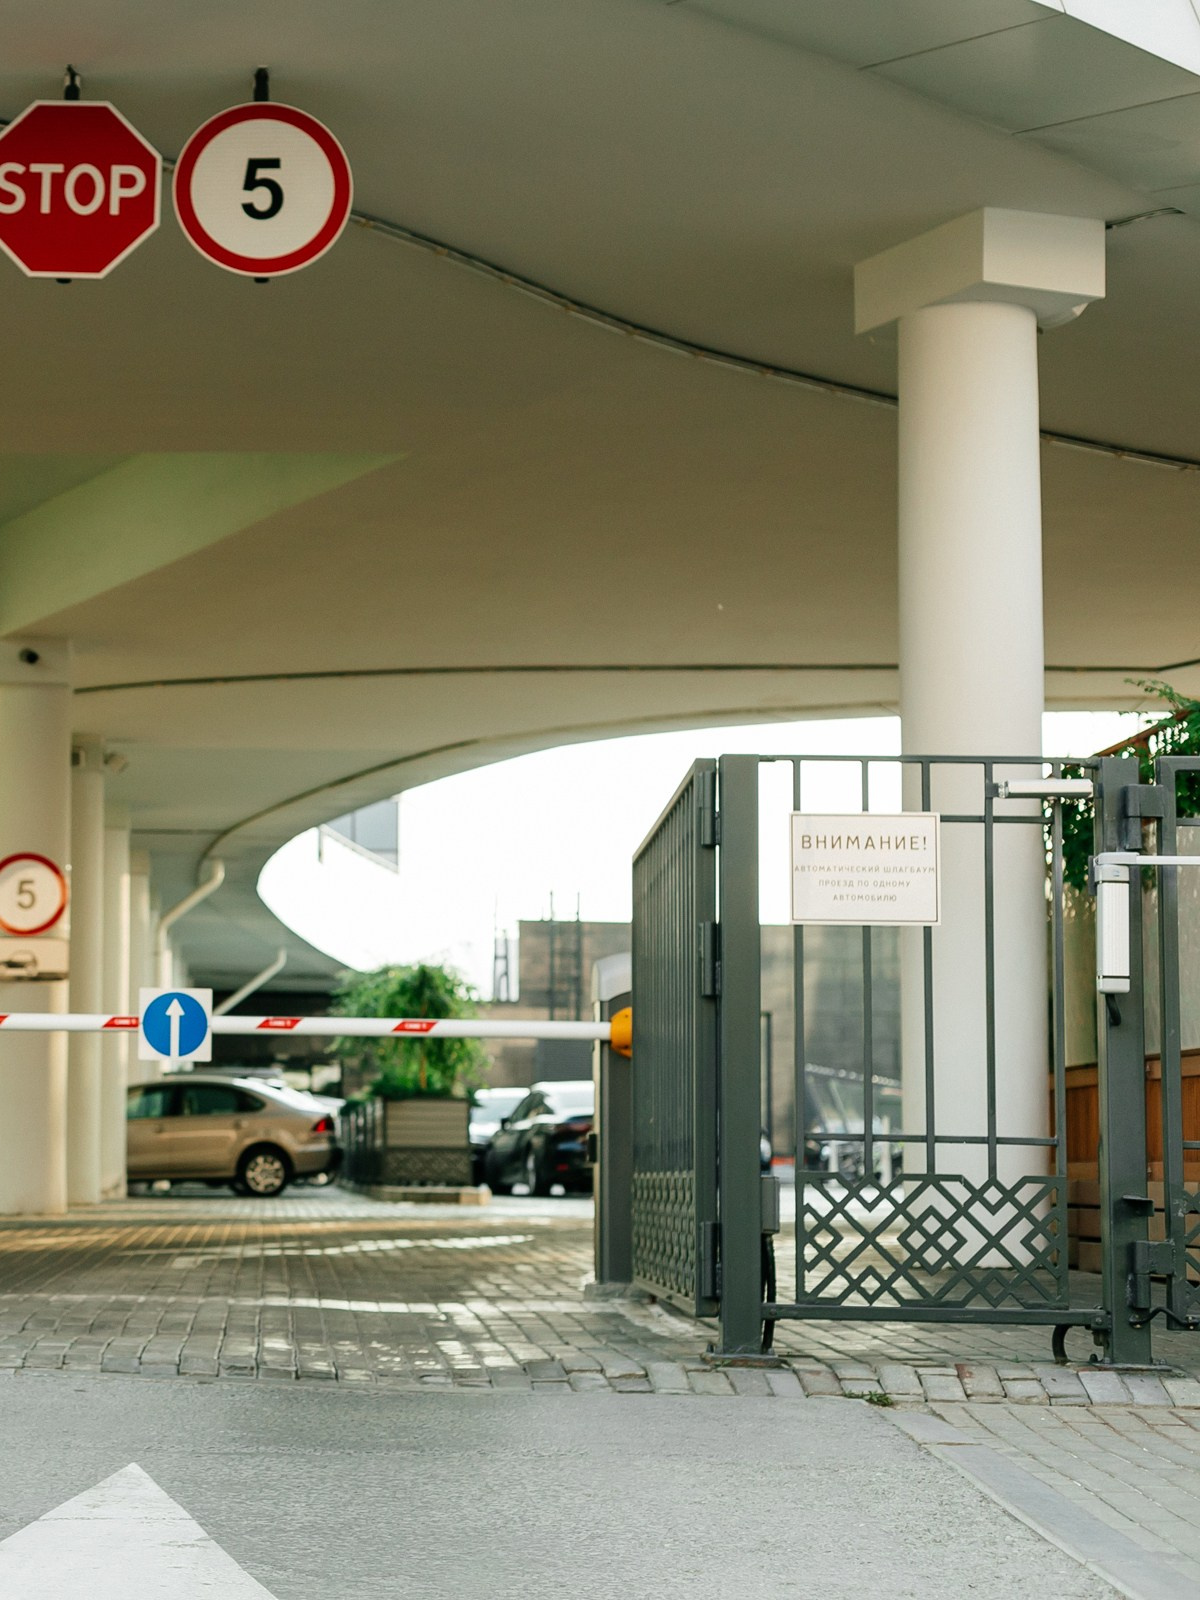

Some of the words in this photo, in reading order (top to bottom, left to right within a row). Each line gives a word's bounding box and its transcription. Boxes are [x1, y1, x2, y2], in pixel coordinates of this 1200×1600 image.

[240, 157, 284, 220] 5
[801, 834, 927, 850] ВНИМАНИЕ!
[794, 865, 880, 873] АВТОМАТИЧЕСКИЙ
[818, 880, 854, 888] ПРОЕЗД
[17, 879, 36, 910] 5
[833, 894, 897, 902] АВТОМОБИЛЮ
